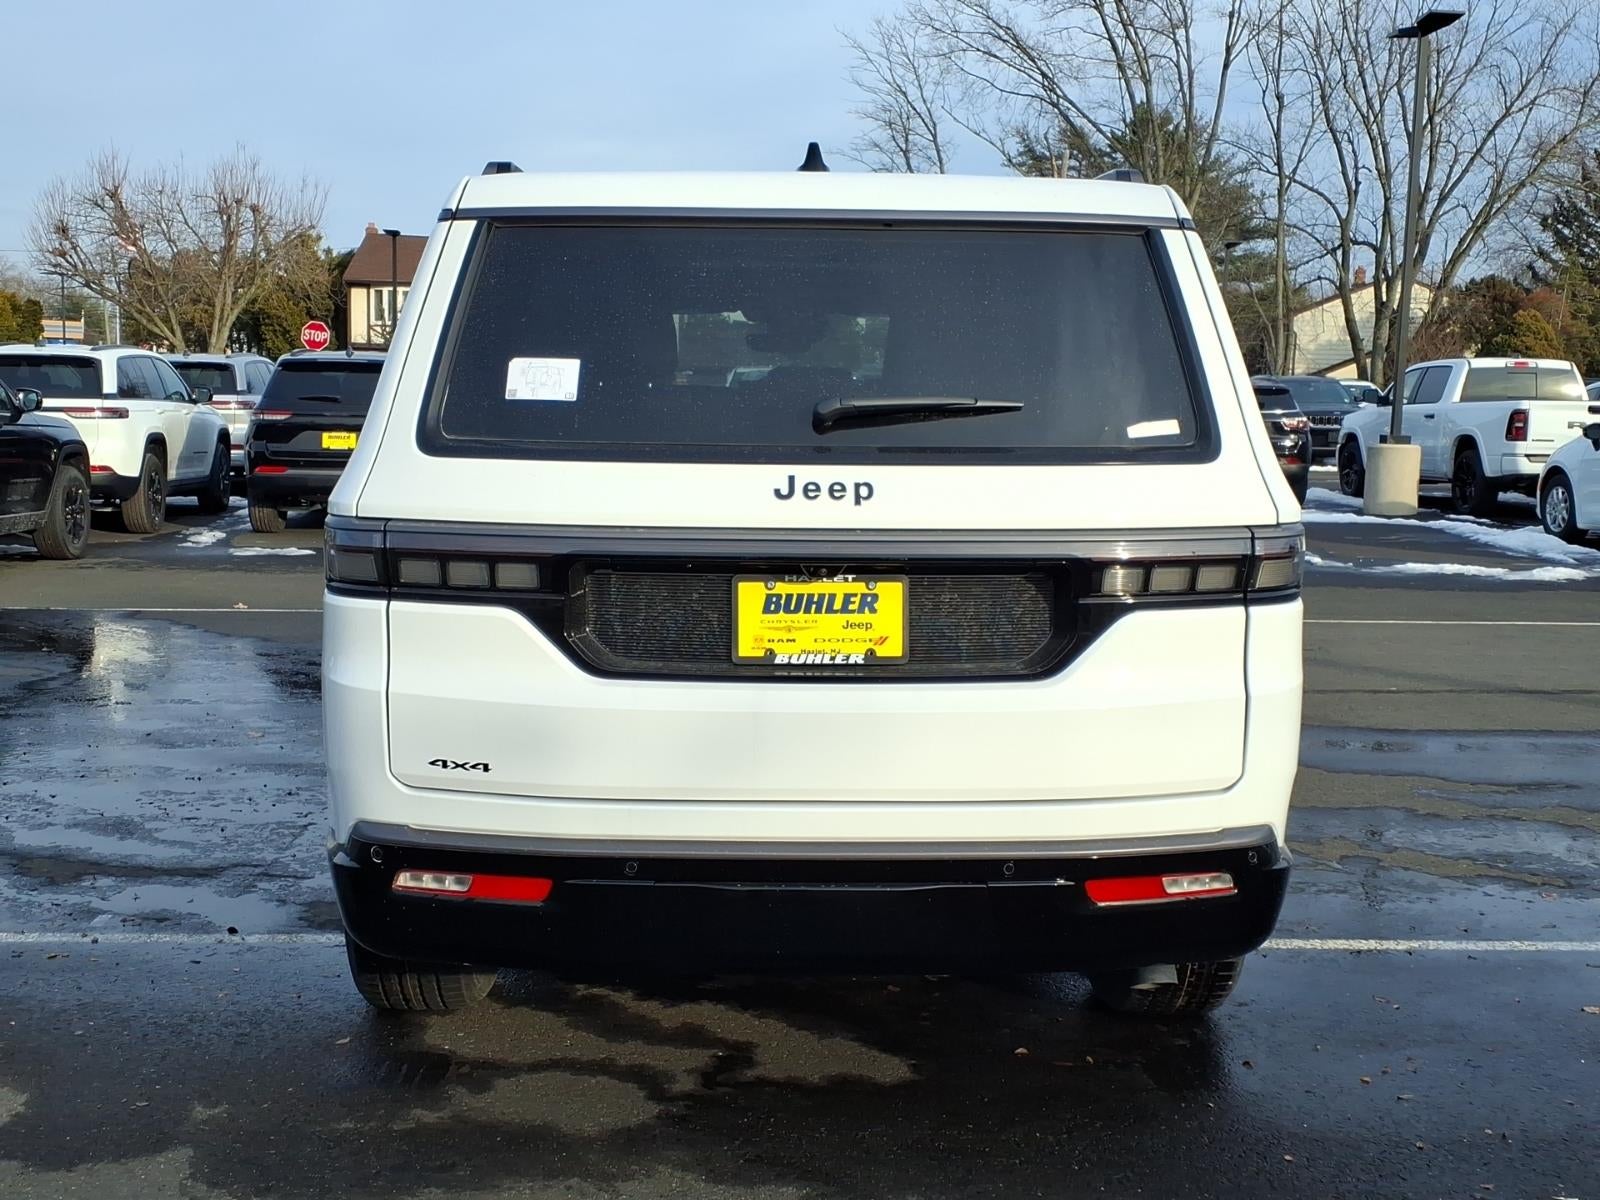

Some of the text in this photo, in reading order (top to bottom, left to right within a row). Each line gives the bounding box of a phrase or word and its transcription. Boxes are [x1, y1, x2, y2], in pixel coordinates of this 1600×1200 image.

[304, 329, 328, 343] STOP
[773, 475, 874, 506] Jeep
[784, 574, 857, 582] HALET
[762, 593, 879, 615] BUHLER
[842, 620, 873, 631] Jeep
[774, 654, 865, 664] BUHLER
[428, 758, 492, 773] 4x4
